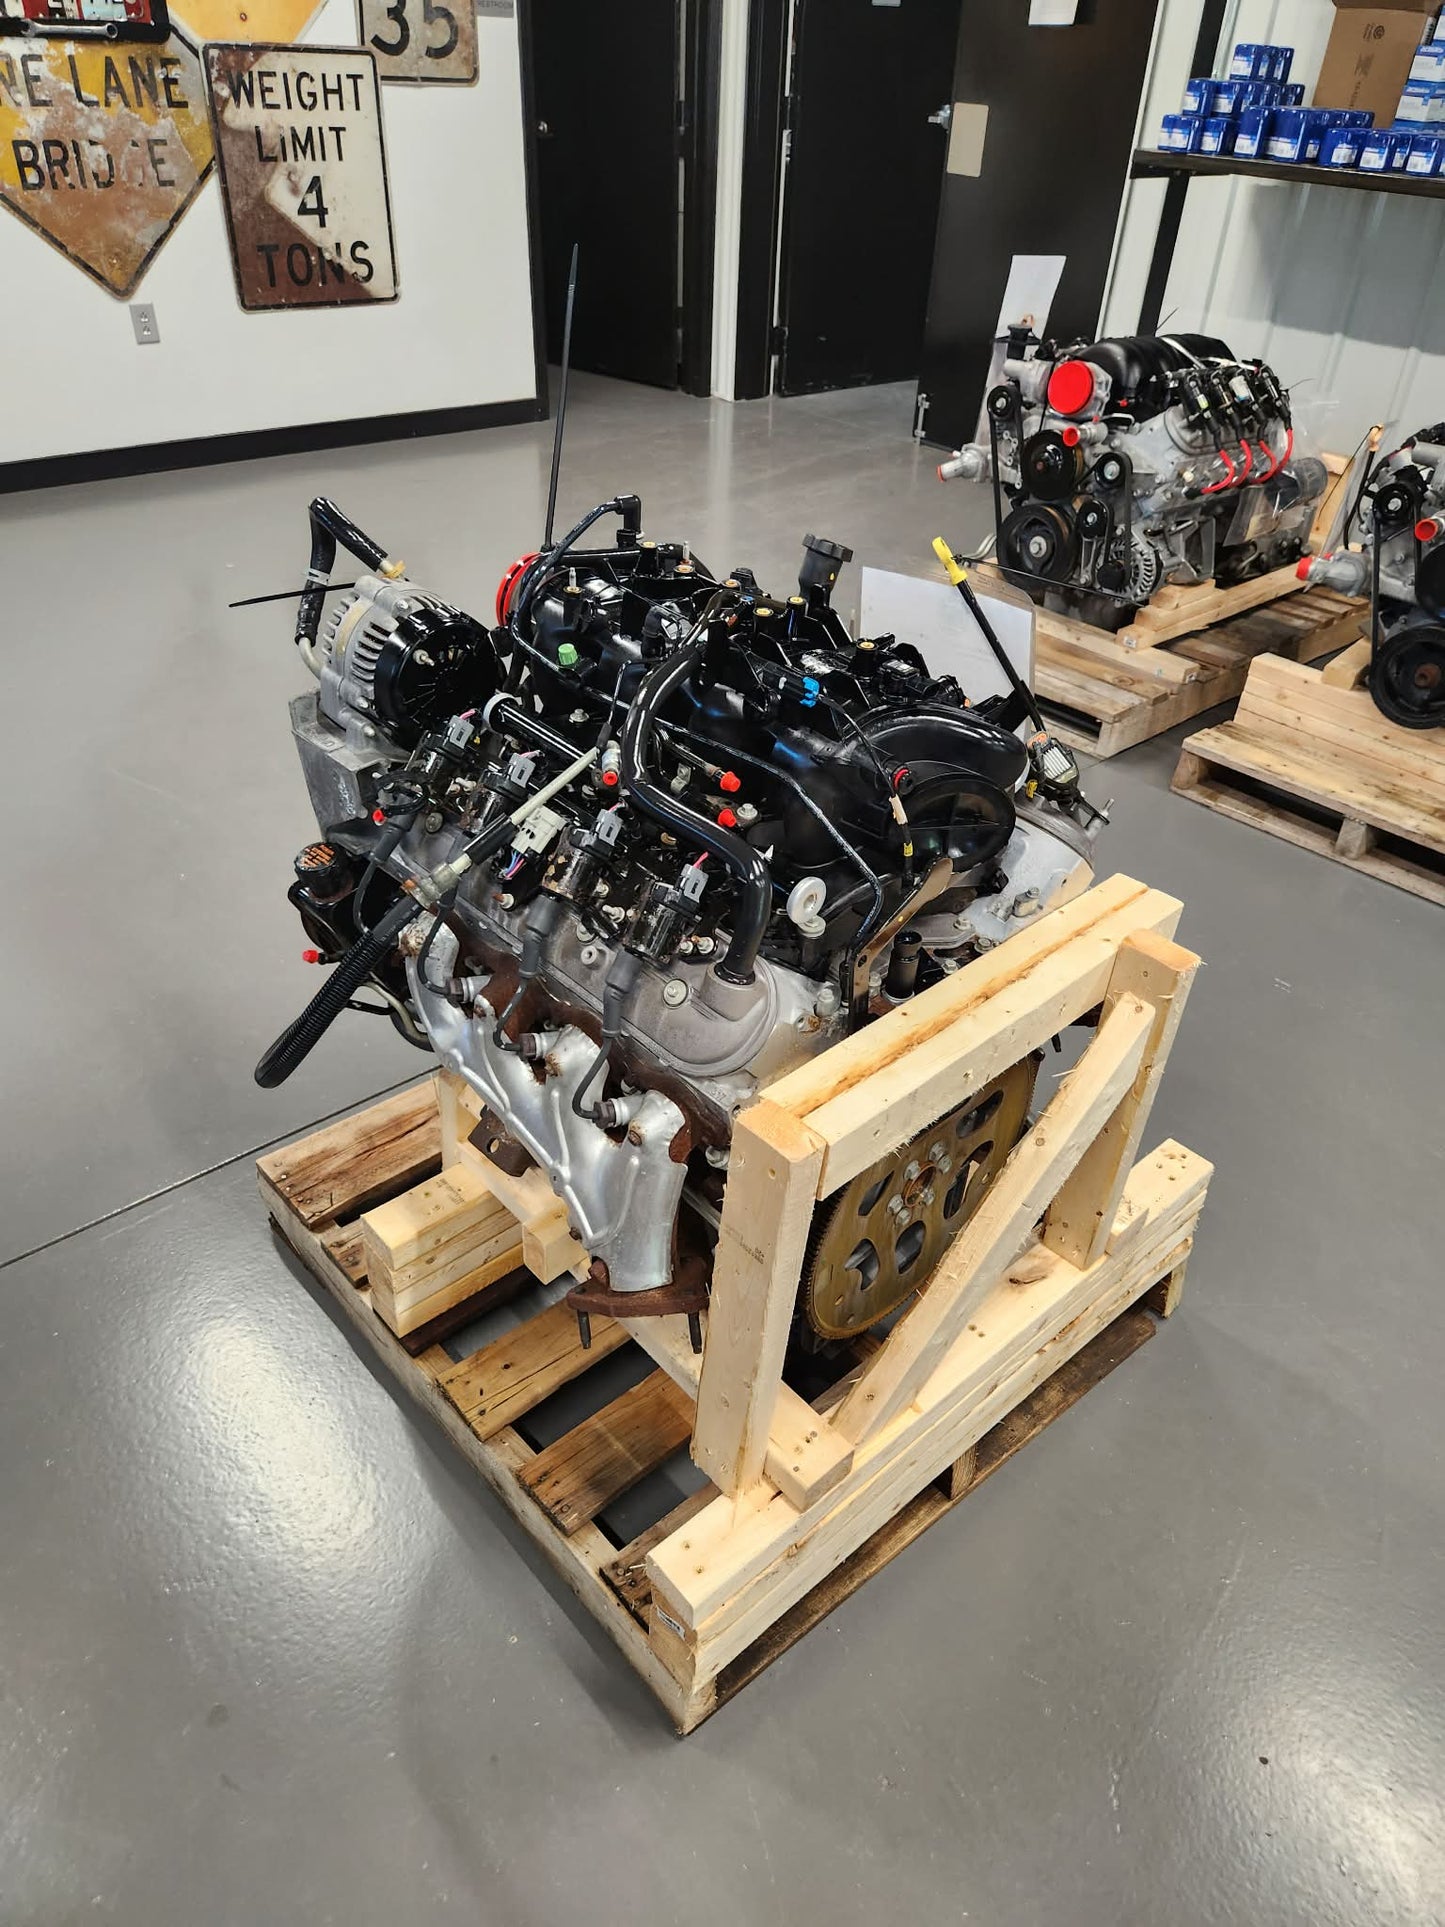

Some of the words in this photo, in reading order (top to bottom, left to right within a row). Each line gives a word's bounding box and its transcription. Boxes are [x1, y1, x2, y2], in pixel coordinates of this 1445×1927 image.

[371, 0, 459, 59] 35
[0, 53, 53, 107] NE
[68, 54, 189, 108] LANE
[226, 71, 364, 112] WEIGHT
[12, 138, 175, 191] BRIDE
[255, 125, 347, 163] LIMIT
[297, 175, 329, 229] 4
[256, 240, 374, 288] TONS
